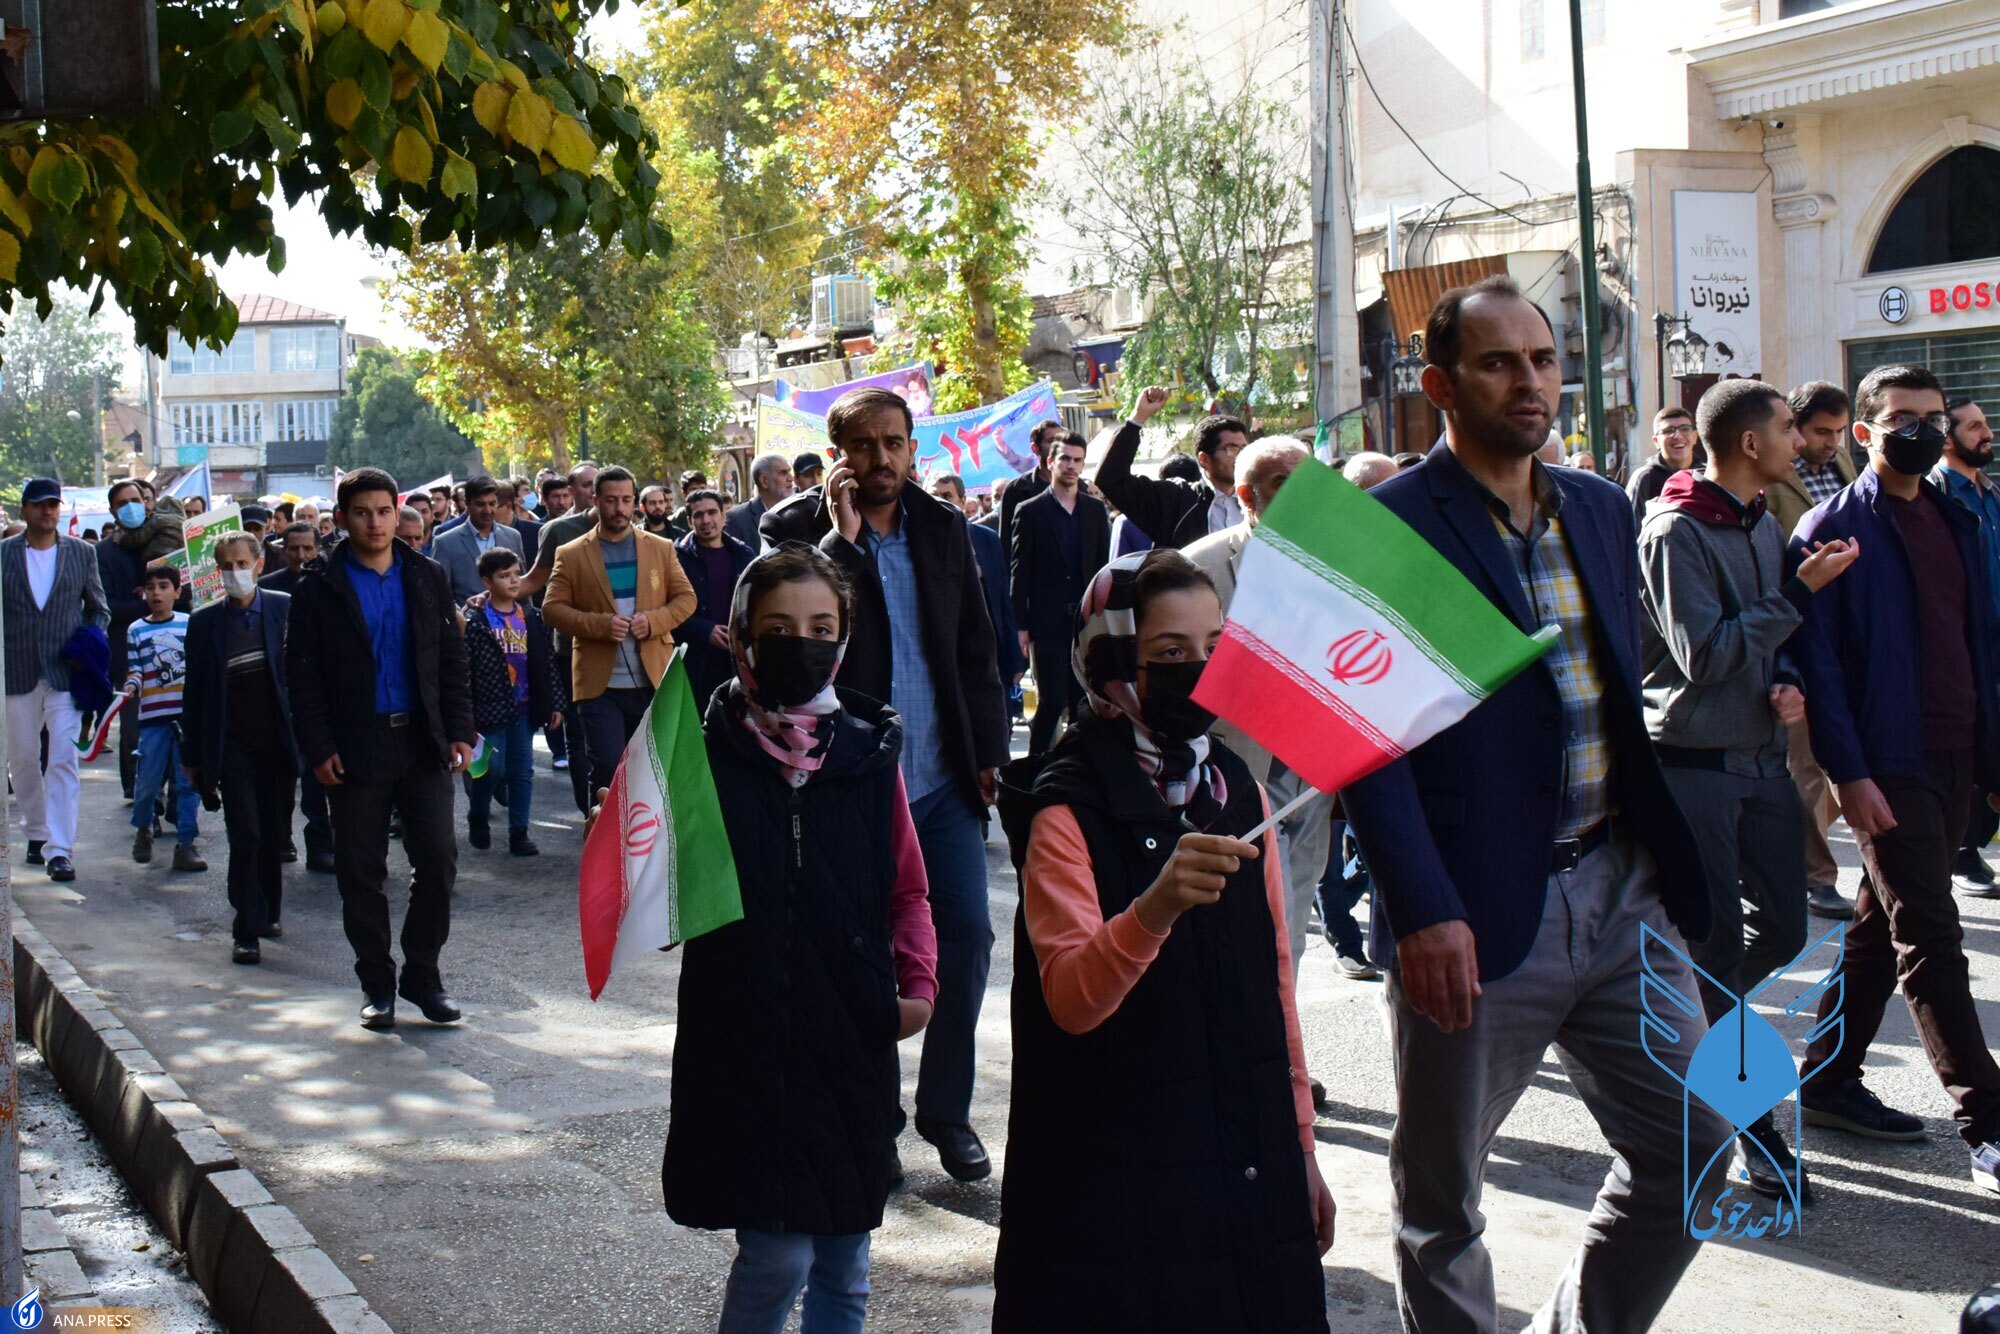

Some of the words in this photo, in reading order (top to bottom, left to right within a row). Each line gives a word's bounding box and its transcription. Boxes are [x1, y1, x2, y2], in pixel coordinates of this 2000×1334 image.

[1690, 246, 1748, 257] NIRVANA
[1690, 286, 1750, 314] نیروانا
[1929, 281, 2000, 313] BOS
[193, 576, 207, 588] WE
[198, 588, 209, 598] TO
